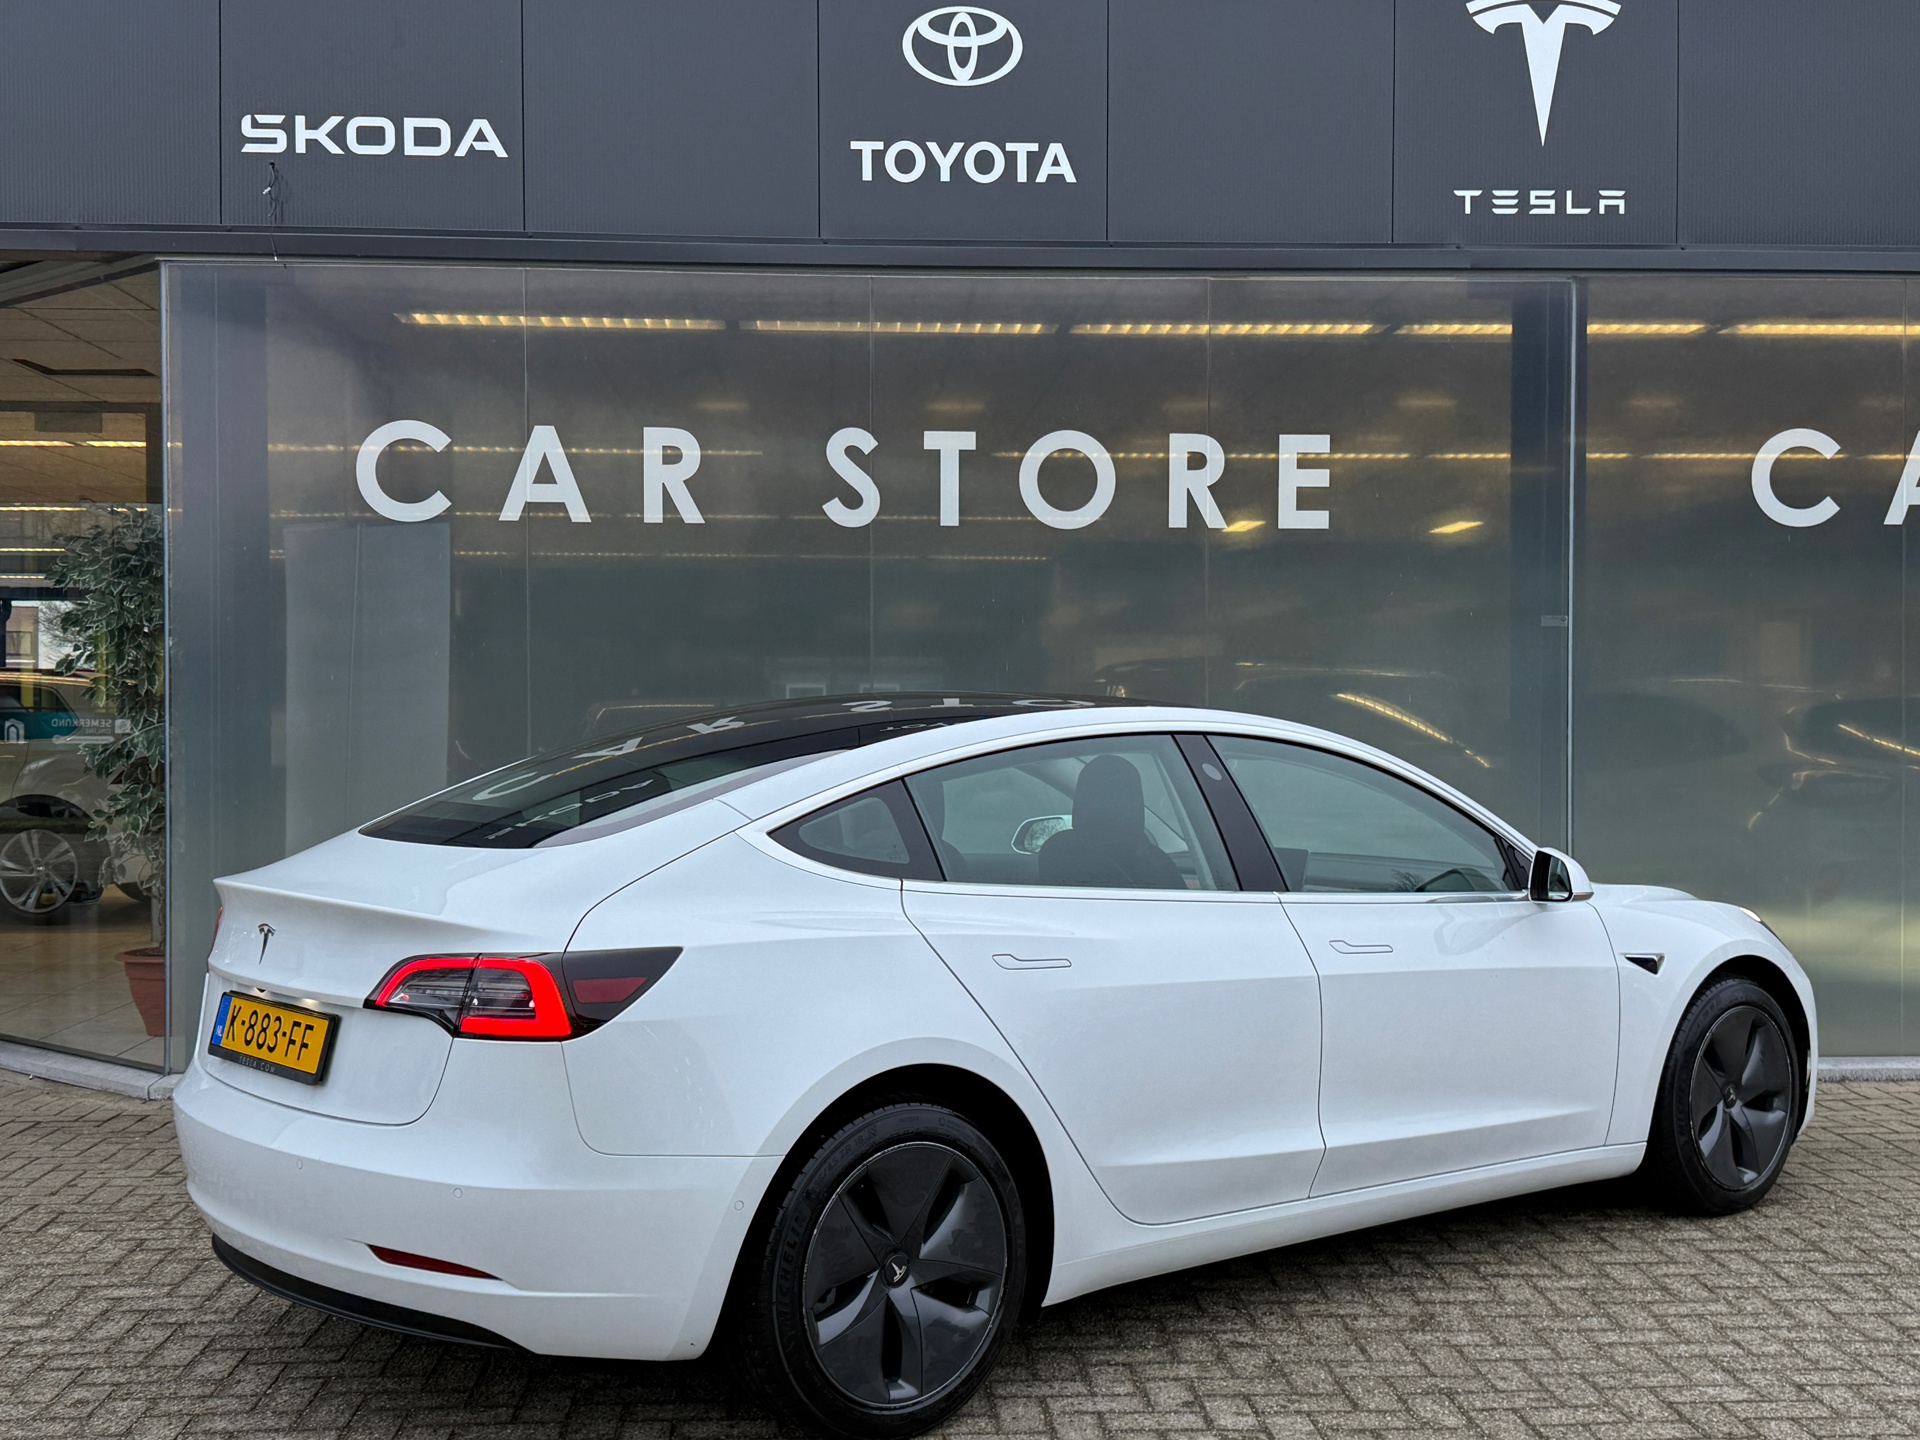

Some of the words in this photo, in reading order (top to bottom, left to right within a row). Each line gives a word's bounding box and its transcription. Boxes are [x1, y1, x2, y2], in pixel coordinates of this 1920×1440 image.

[850, 140, 1077, 184] TOYOTA
[1453, 189, 1626, 215] TESLA
[355, 419, 706, 524] CAR
[822, 427, 1331, 531] STORE
[226, 1004, 314, 1061] K-883-FF
